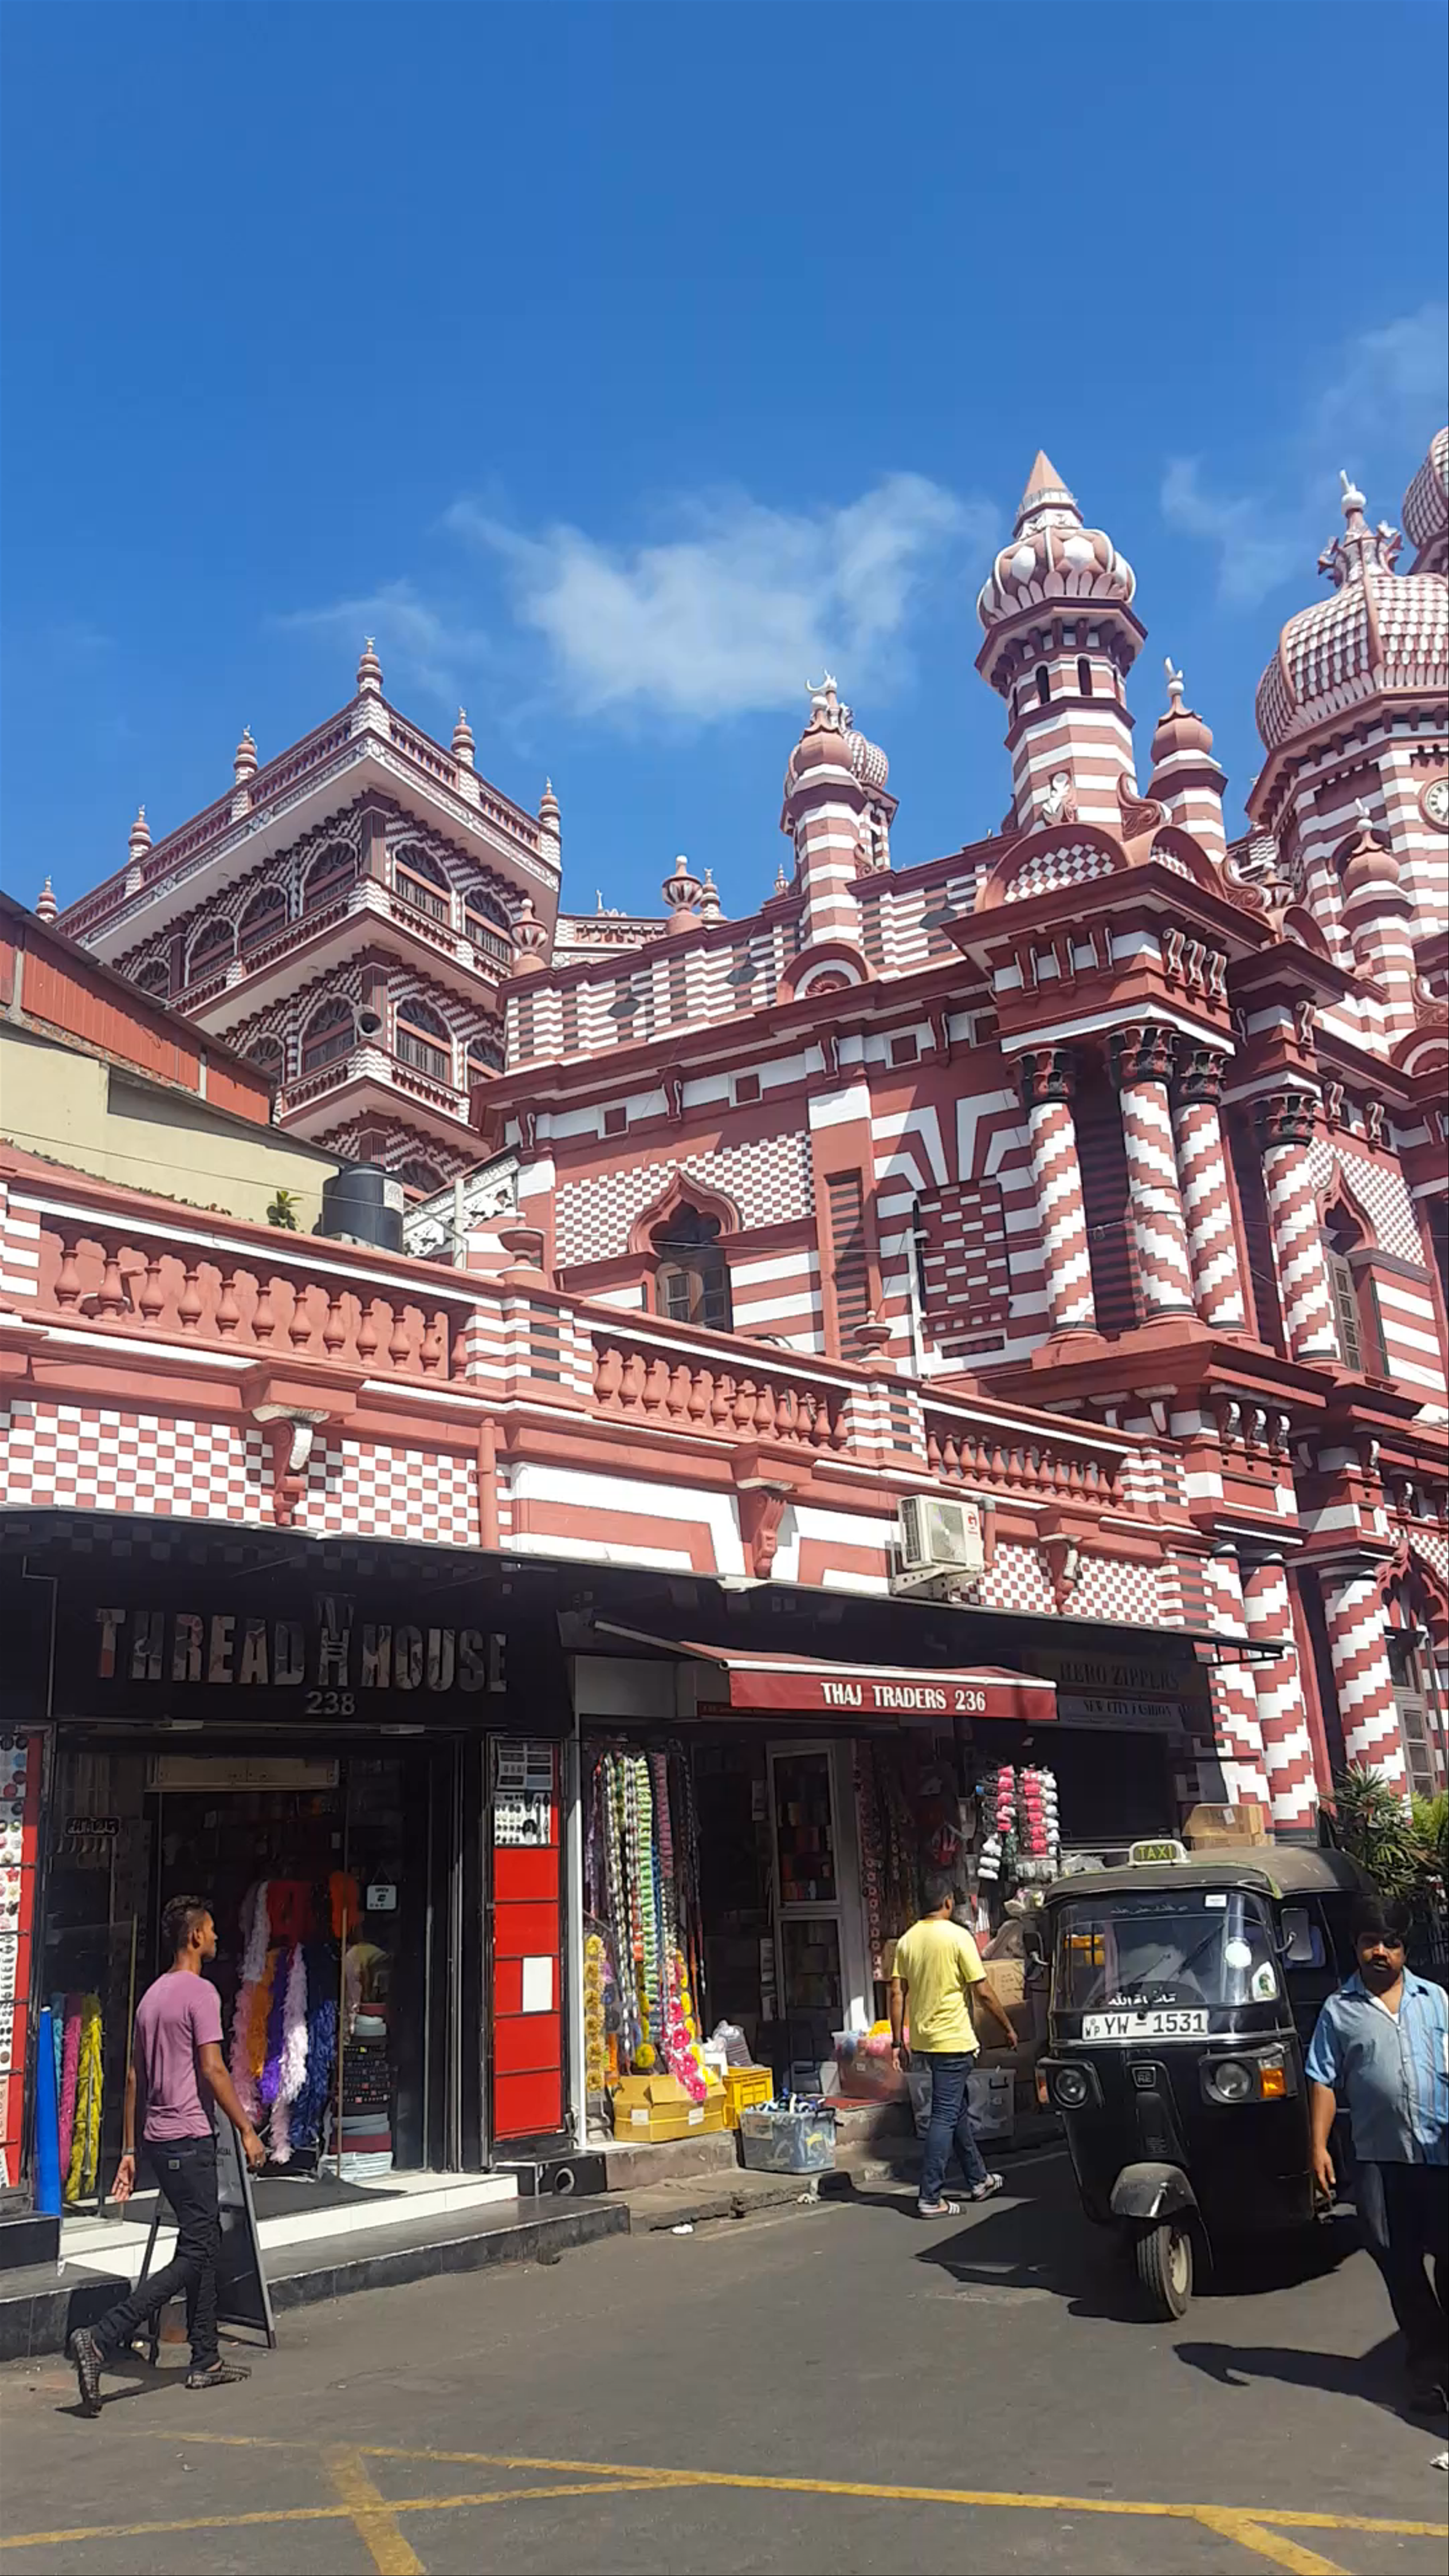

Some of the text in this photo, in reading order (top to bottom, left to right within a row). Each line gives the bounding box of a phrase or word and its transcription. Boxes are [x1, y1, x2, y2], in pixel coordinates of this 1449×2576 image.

[96, 1608, 305, 1686] THREAD
[360, 1624, 508, 1693] HOUSE
[305, 1690, 356, 1716] 238
[820, 1682, 986, 1711] THAJ TRADERS 236
[1138, 1845, 1173, 1859] TAXI
[1104, 2016, 1130, 2035] YW
[1153, 2013, 1206, 2033] 1531
